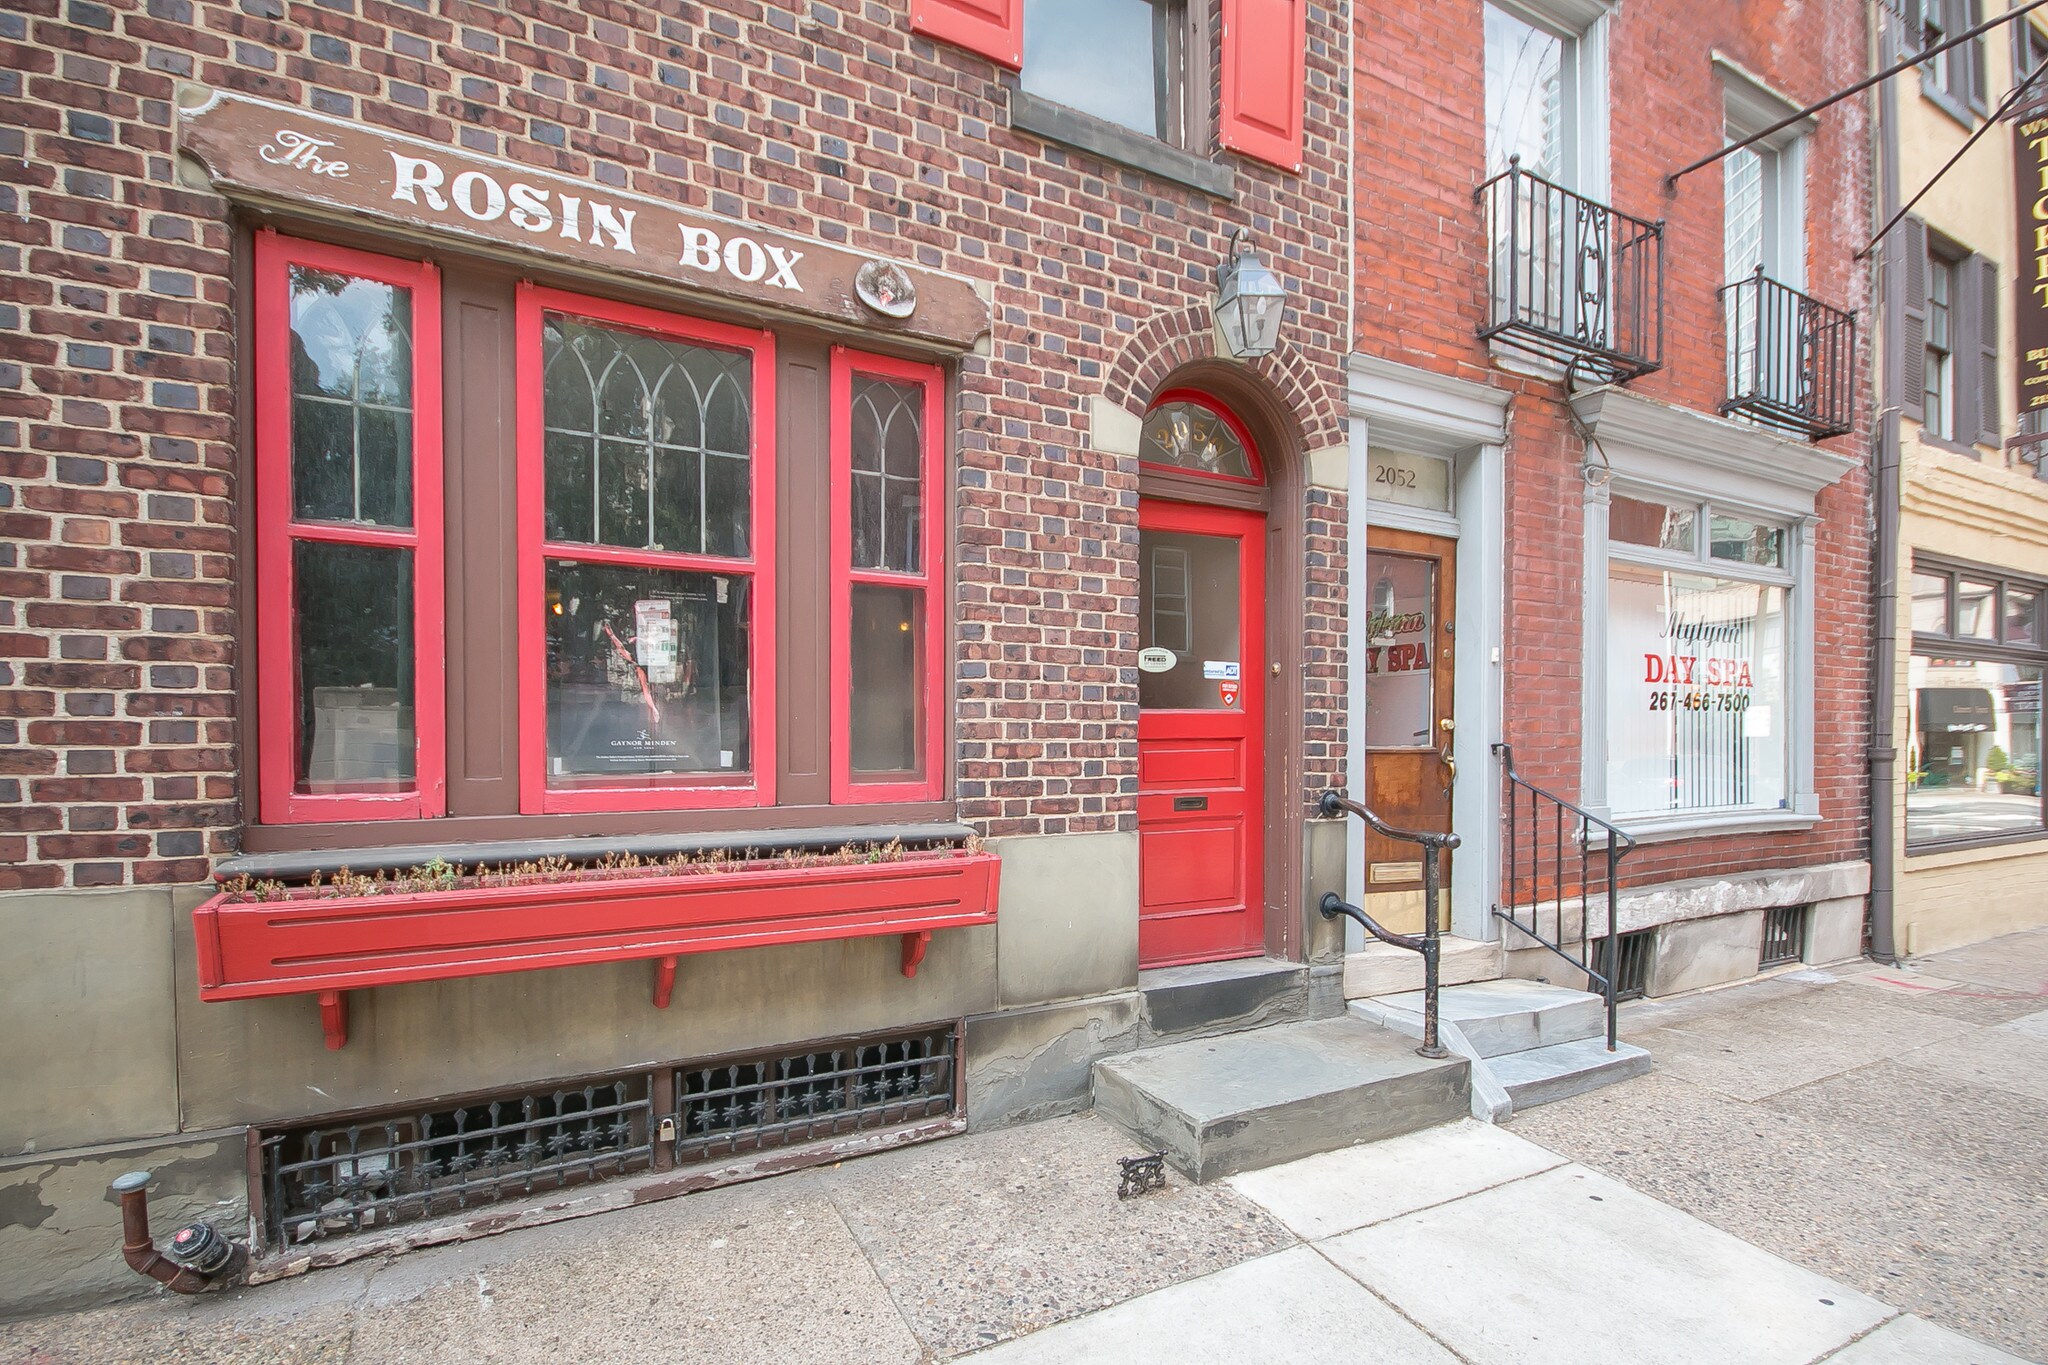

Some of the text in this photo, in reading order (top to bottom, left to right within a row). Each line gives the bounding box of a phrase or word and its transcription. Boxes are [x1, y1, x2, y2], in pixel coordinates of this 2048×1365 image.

[259, 129, 804, 293] The ROSIN BOX
[1375, 465, 1417, 489] 2052
[1387, 642, 1430, 673] SPA
[1644, 653, 1754, 688] DAY SPA
[1649, 691, 1751, 712] 267-466-7500
